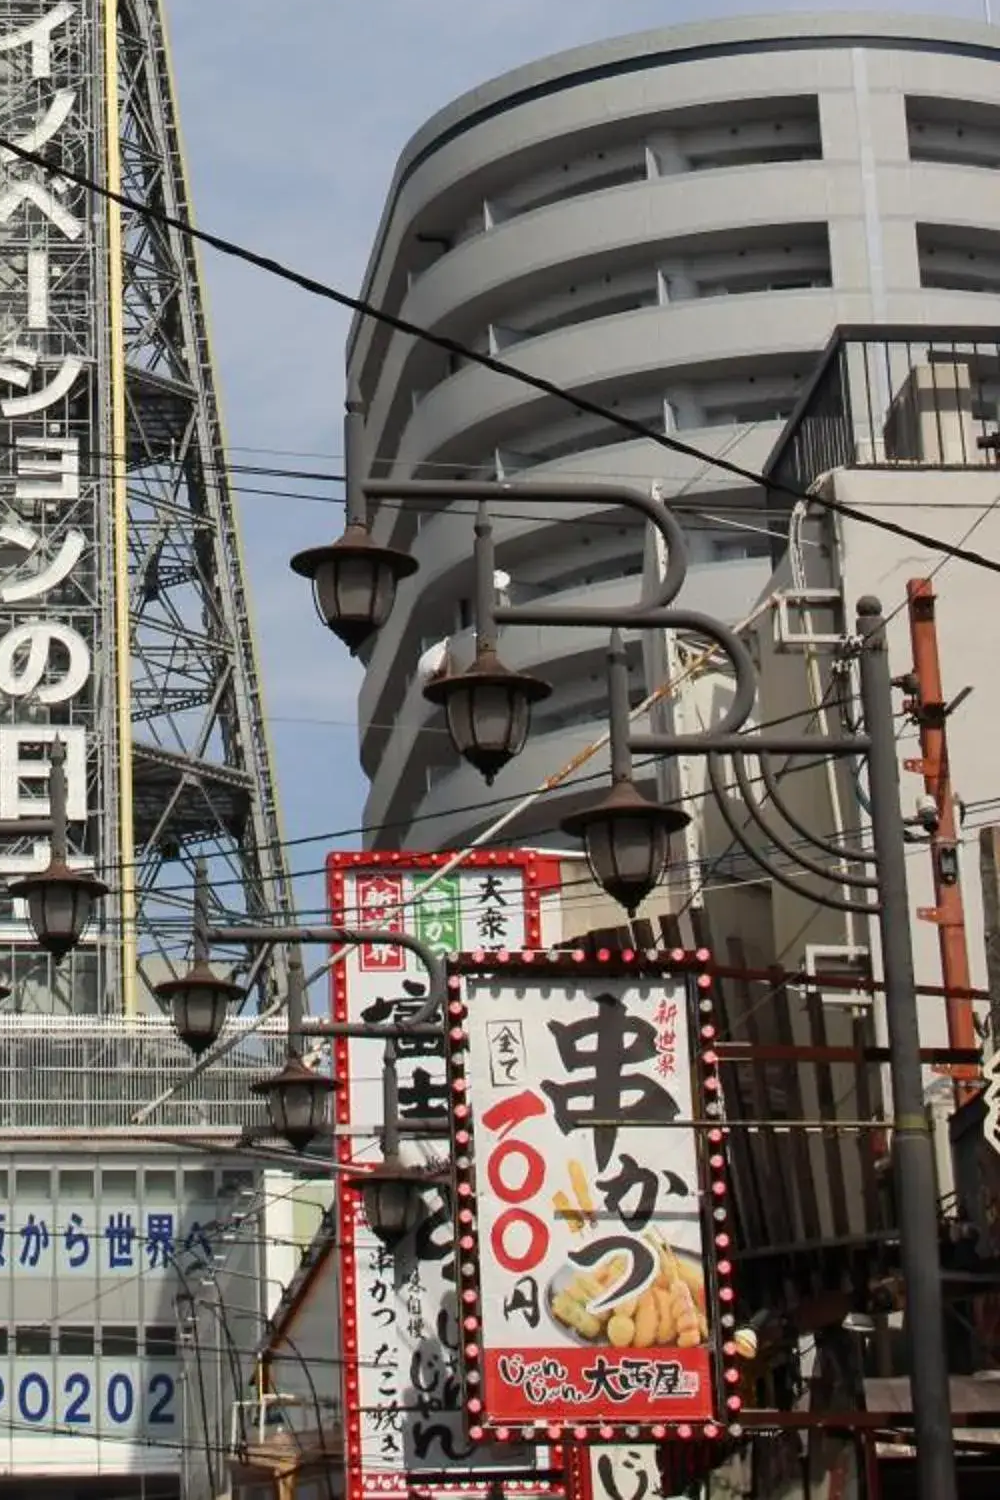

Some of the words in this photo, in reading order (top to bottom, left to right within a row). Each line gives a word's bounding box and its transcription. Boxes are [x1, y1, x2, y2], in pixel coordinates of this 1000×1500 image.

[476, 874, 508, 952] 大衆
[491, 1025, 520, 1081] 全て
[652, 999, 678, 1078] 新世界
[540, 993, 690, 1309] 串かつ
